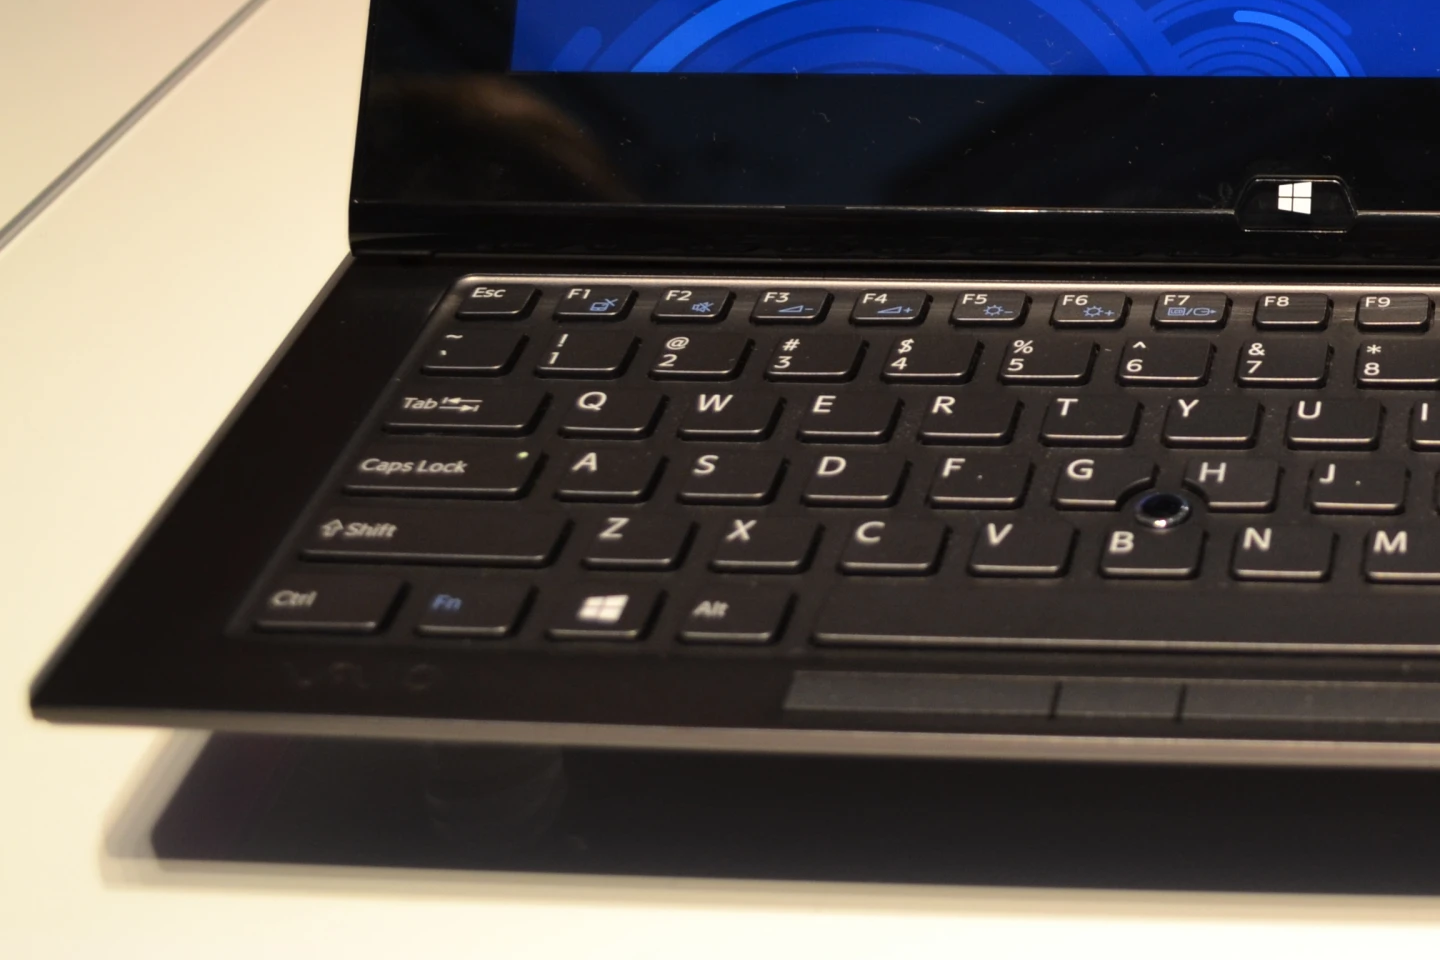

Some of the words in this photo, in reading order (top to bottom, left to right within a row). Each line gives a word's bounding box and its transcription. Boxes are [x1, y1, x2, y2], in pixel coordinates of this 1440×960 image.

[471, 287, 506, 299] Esc
[567, 288, 591, 299] F1
[665, 289, 692, 302] F2
[763, 292, 791, 303] F3
[862, 293, 888, 304] F4
[962, 293, 988, 305] F5
[1062, 294, 1088, 306] F6
[1164, 295, 1191, 306] F7
[1264, 296, 1290, 308] F8
[1365, 297, 1391, 308] F9
[1248, 342, 1266, 356] &
[547, 352, 560, 364] 1
[659, 354, 676, 367] 2
[773, 355, 791, 369] 3
[891, 357, 908, 370] 4
[1007, 358, 1024, 372] 5
[1126, 359, 1143, 373] 6
[1246, 360, 1263, 374] 7
[1363, 362, 1380, 376] 8
[403, 396, 438, 410] Tab
[577, 392, 608, 410] Q
[698, 394, 733, 412] W
[813, 395, 836, 413] E
[932, 396, 957, 414] R
[1056, 398, 1079, 416] T
[1177, 399, 1199, 417] Y
[1298, 401, 1322, 419] U
[360, 458, 413, 474] Caps
[415, 458, 468, 474] Lock
[572, 453, 599, 472] A
[693, 455, 720, 475] S
[817, 456, 847, 476] D
[942, 458, 966, 477] F
[1067, 460, 1094, 480] G
[1200, 462, 1227, 482] H
[1319, 463, 1336, 484] J
[344, 522, 397, 537] Shift
[599, 518, 629, 538] Z
[727, 520, 757, 540] X
[855, 521, 885, 543] C
[986, 523, 1013, 545] V
[1109, 531, 1135, 552] B
[1242, 528, 1271, 550] N
[1373, 531, 1408, 553] M
[270, 590, 316, 607] Ctrl
[432, 595, 462, 611] Fn
[694, 600, 728, 616] Alt
